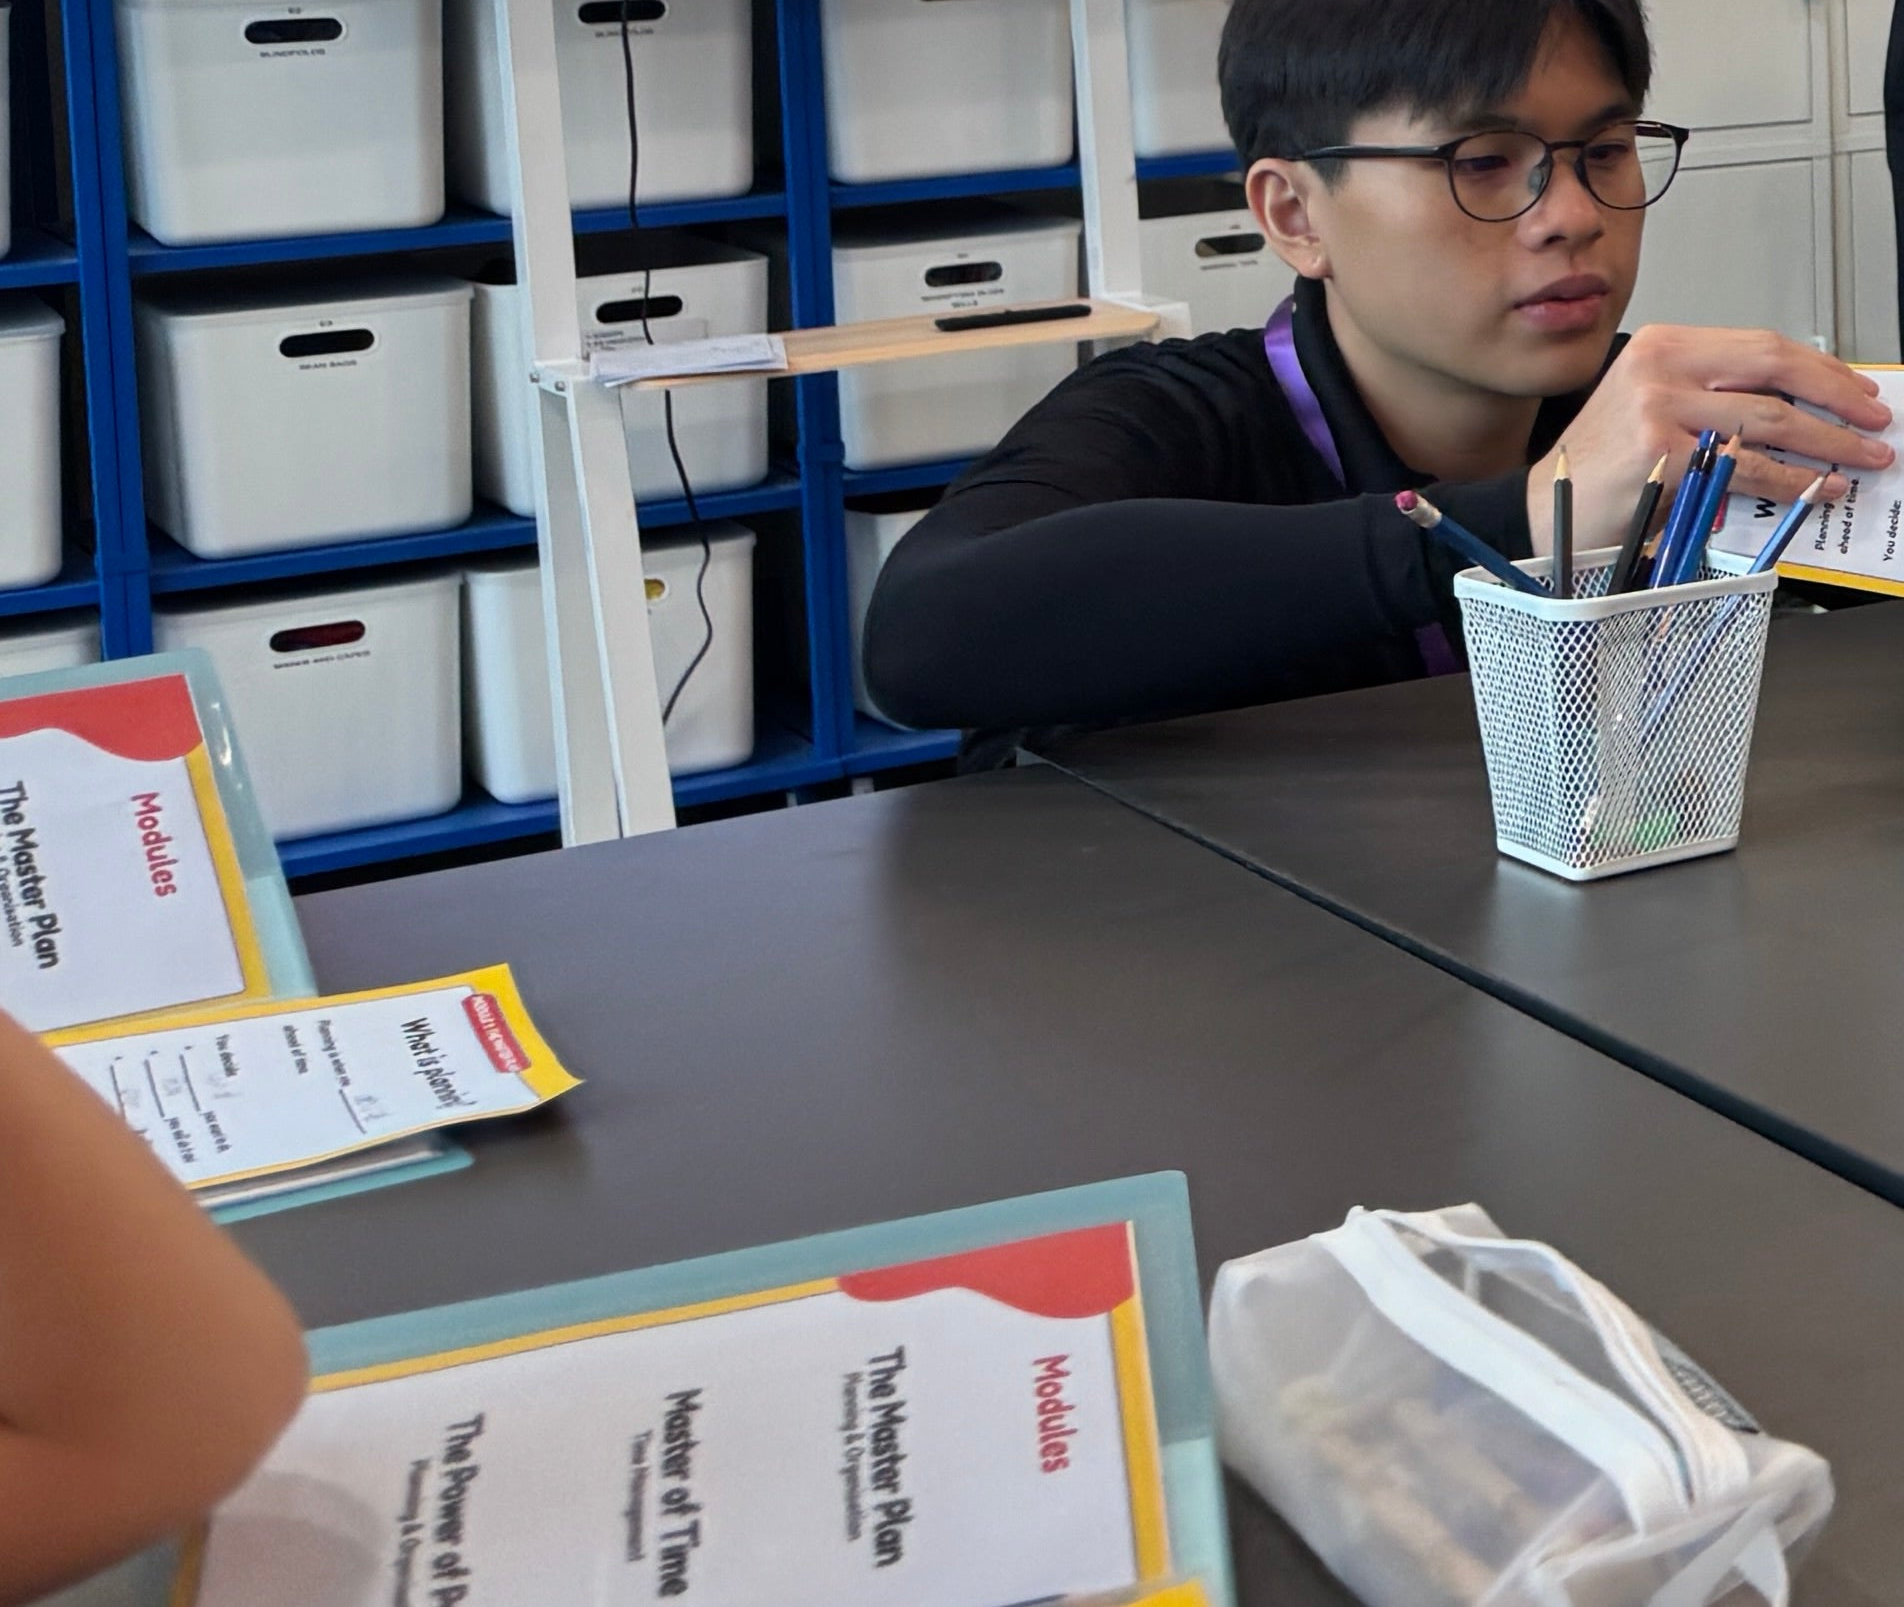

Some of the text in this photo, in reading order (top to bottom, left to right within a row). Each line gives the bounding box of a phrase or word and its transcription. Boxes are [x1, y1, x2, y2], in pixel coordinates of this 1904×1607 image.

[1882, 499, 1902, 562] You decide:
[0, 780, 62, 969] The Master Plan
[128, 791, 179, 897] Modules
[401, 1016, 433, 1056] What
[416, 1054, 447, 1070] is
[443, 1412, 485, 1464] The
[630, 1429, 653, 1465] Time
[1032, 1354, 1078, 1473] Modules
[657, 1387, 702, 1598] Master of Time
[868, 1345, 916, 1568] The Master Plan
[434, 1464, 480, 1546] Power
[431, 1551, 472, 1580] of
